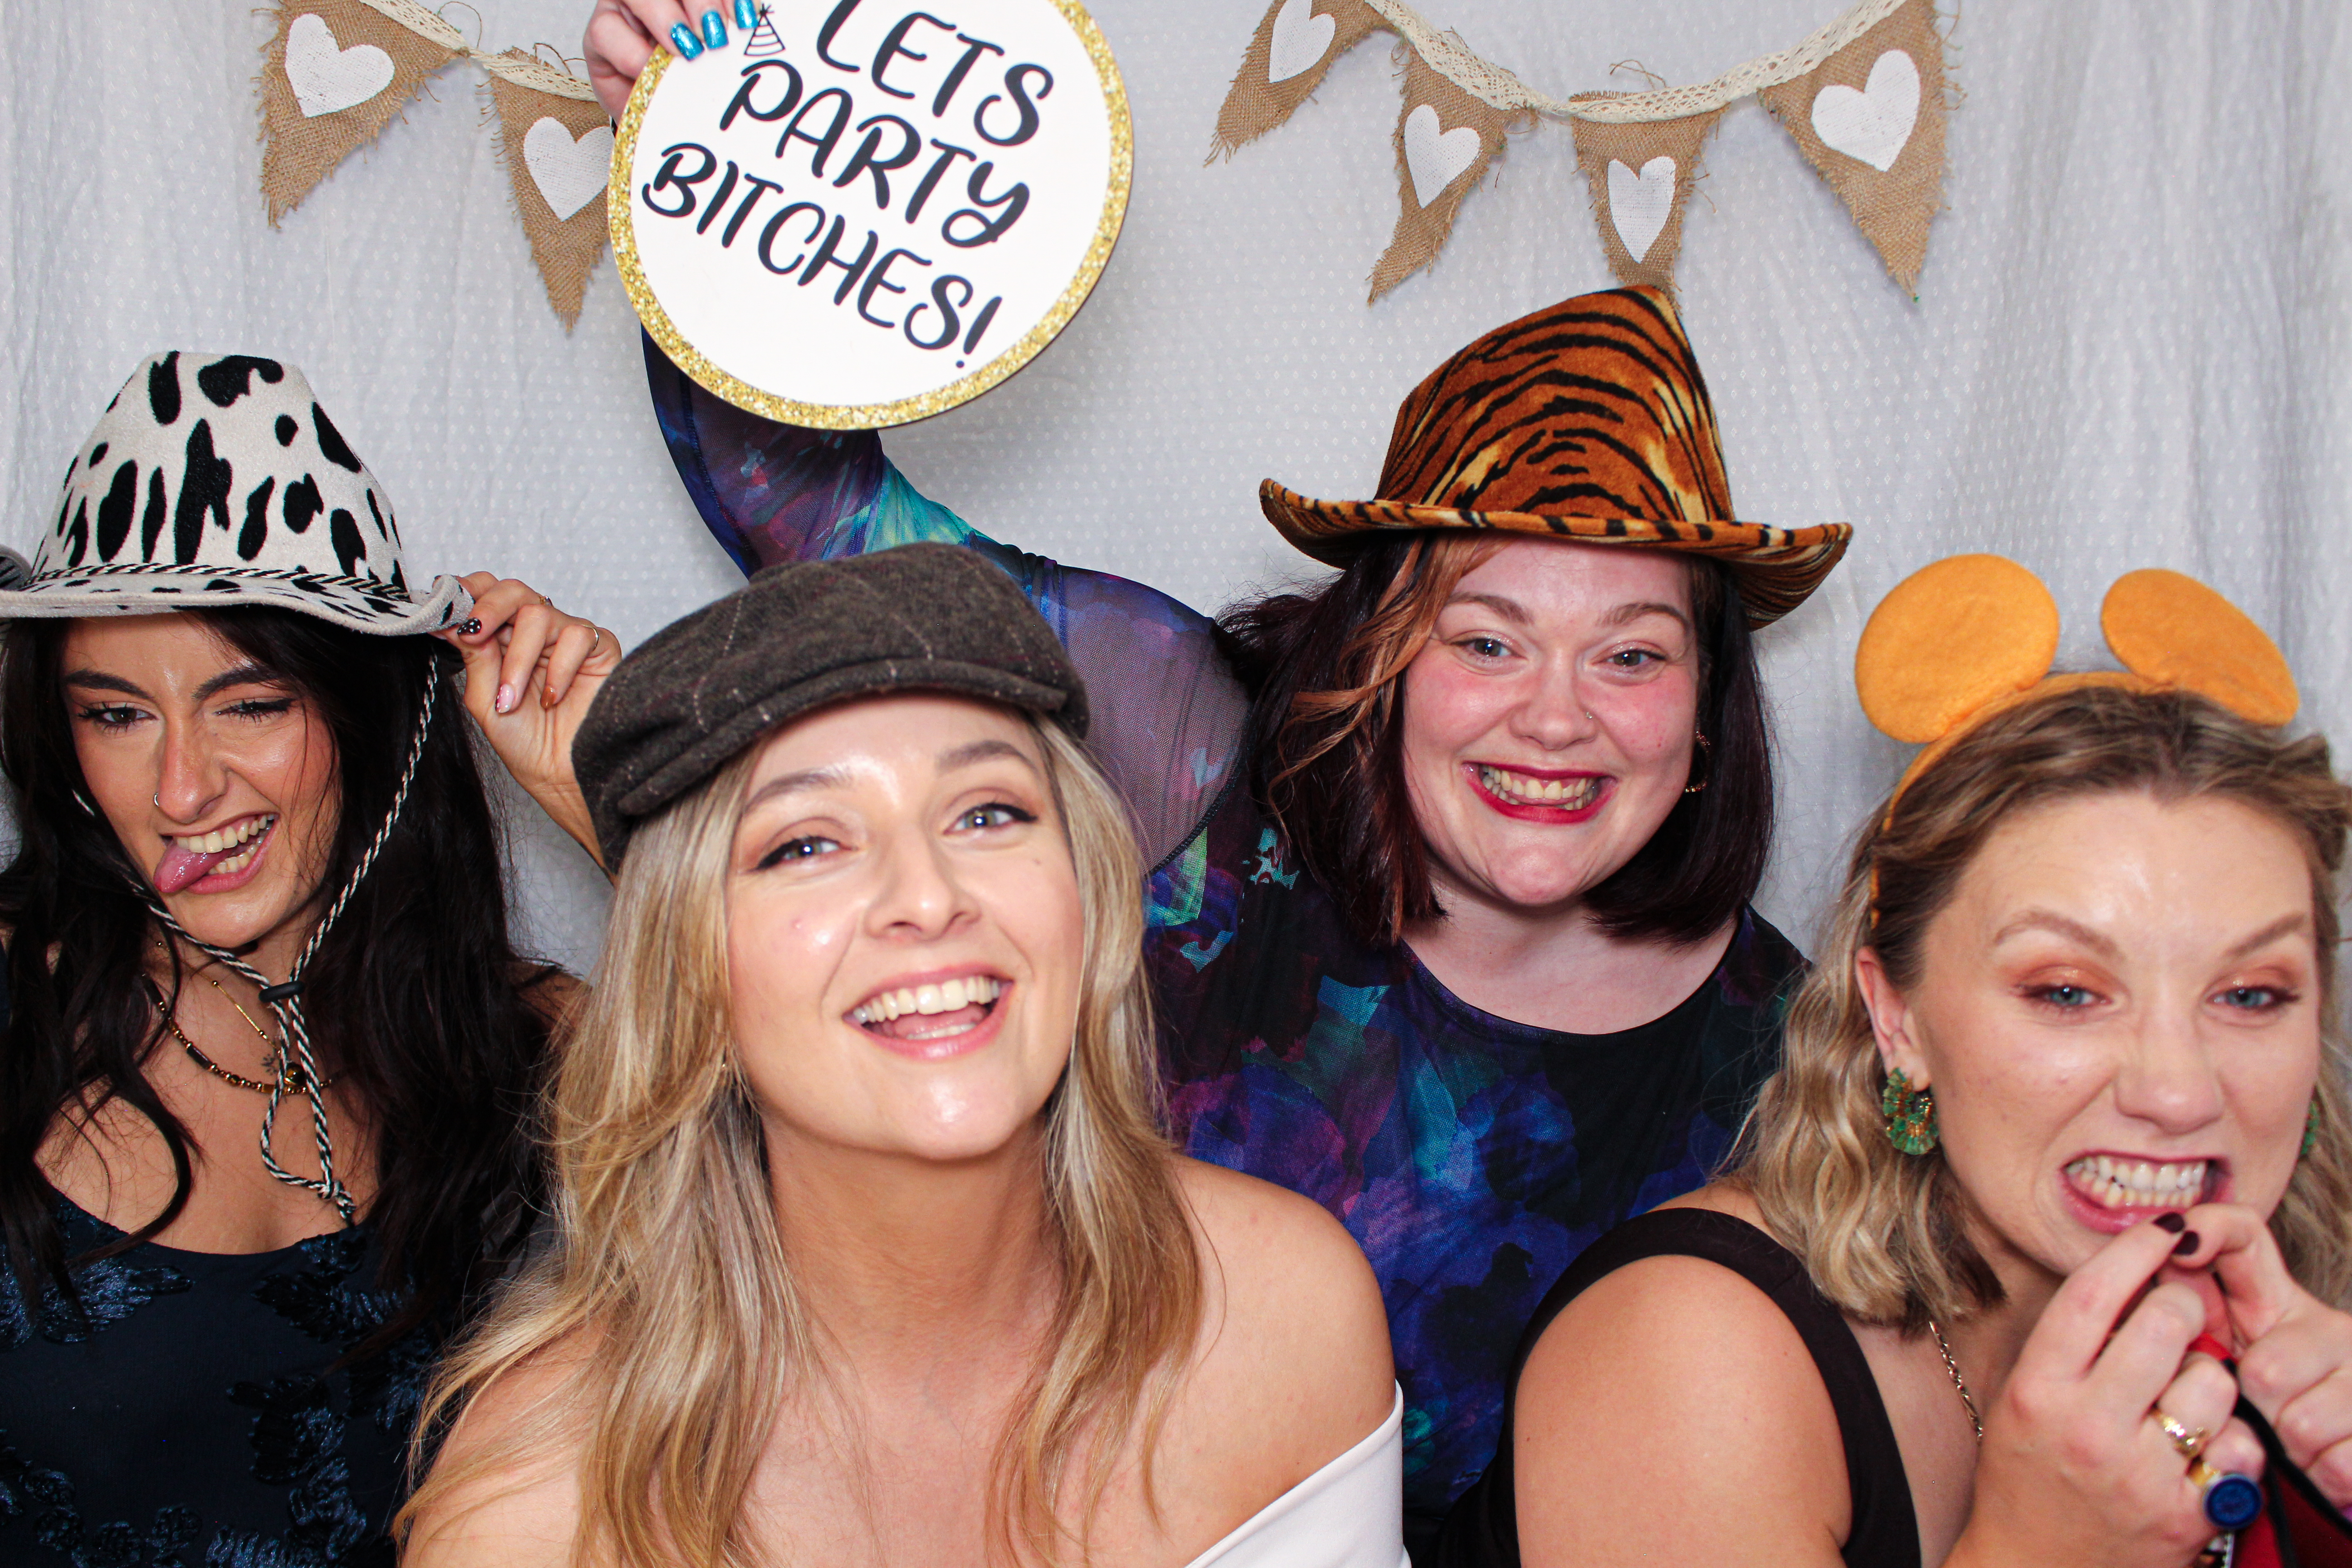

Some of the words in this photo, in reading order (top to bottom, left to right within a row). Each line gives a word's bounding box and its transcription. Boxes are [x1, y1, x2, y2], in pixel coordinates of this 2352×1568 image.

[720, 59, 1030, 248] PARTY
[816, 0, 1054, 147] LETS
[641, 142, 1003, 368] BITCHES!
